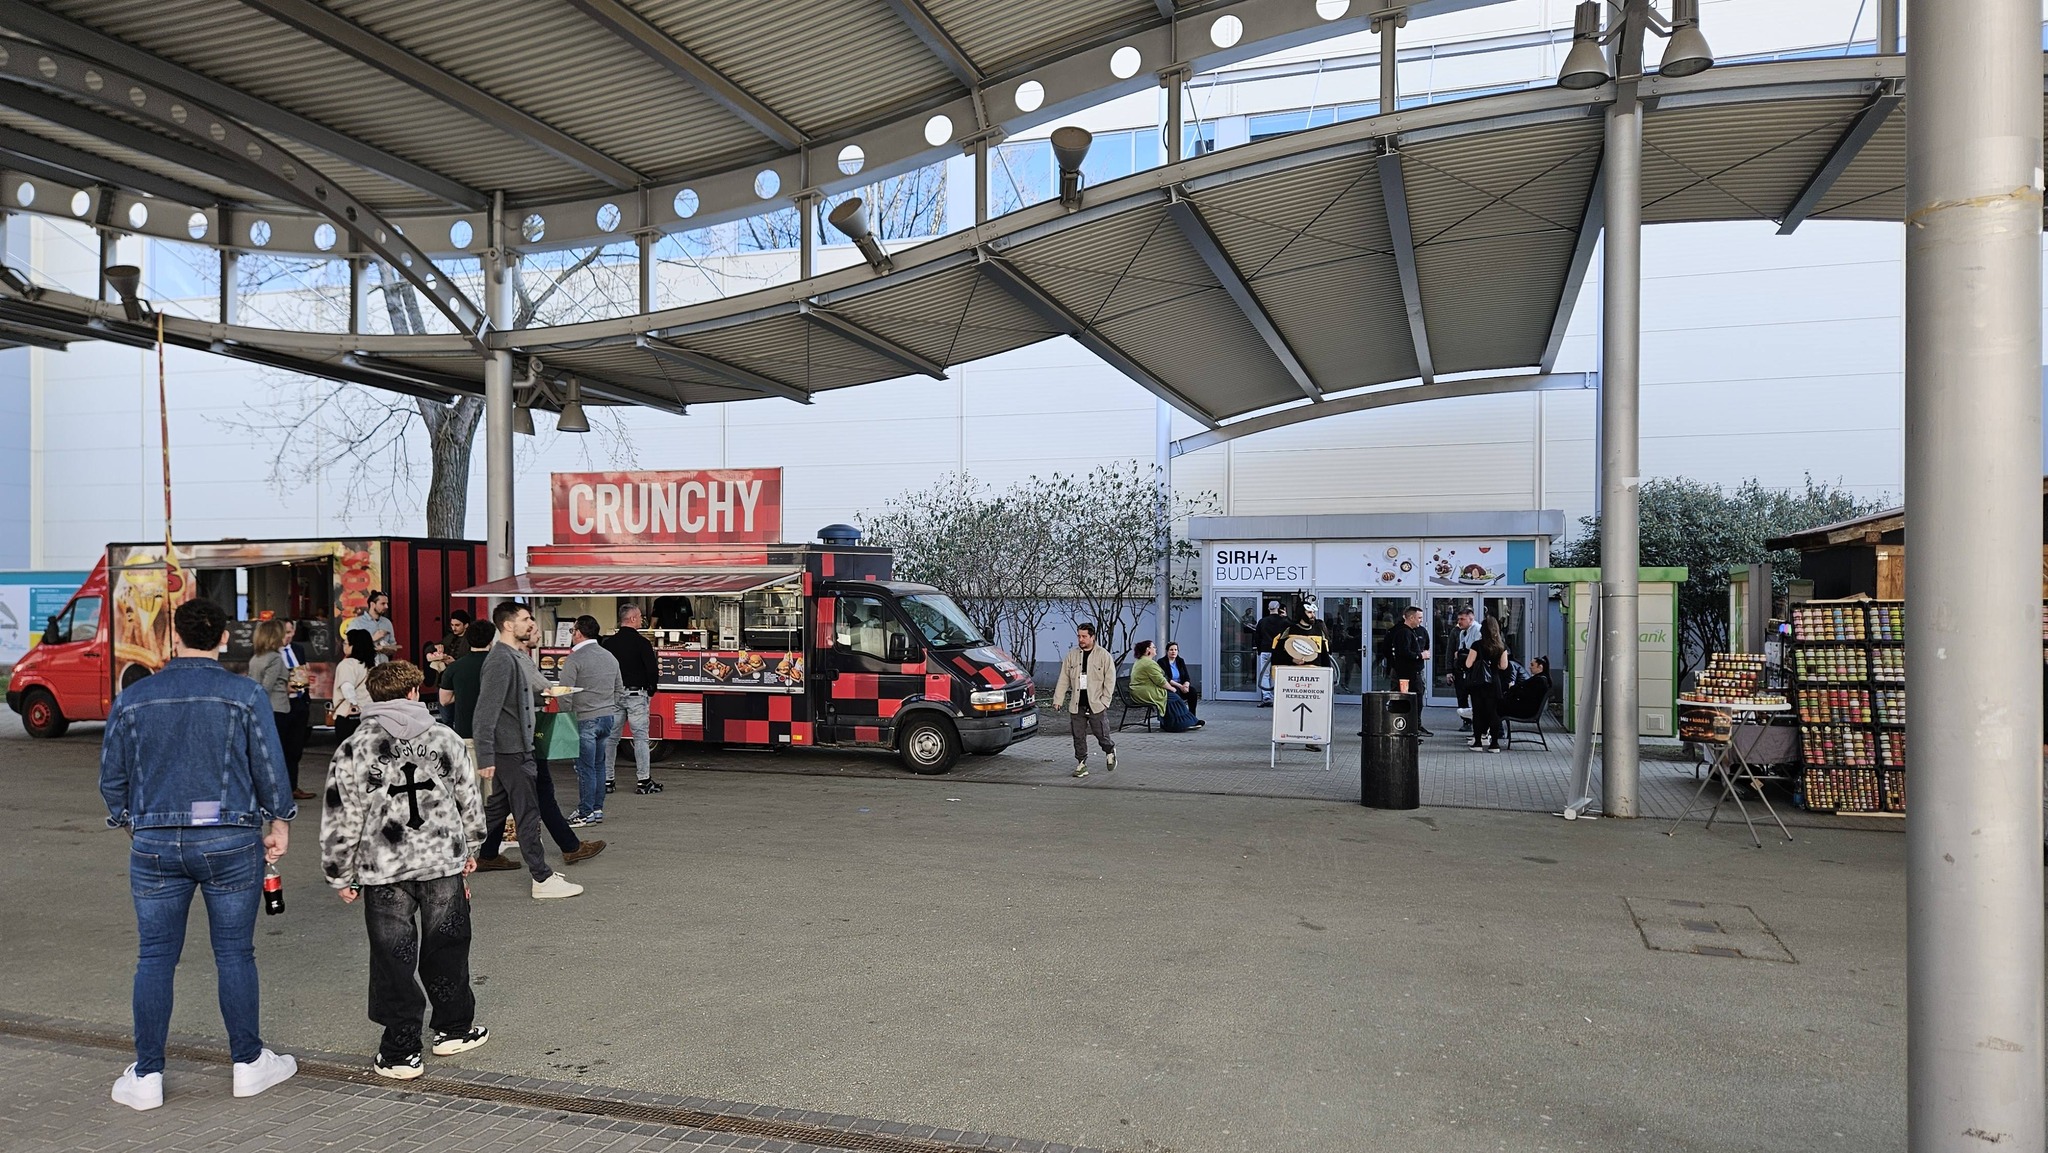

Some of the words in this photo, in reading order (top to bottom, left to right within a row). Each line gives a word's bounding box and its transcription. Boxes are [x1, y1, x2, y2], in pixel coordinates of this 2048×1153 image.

[568, 479, 763, 535] CRUNCHY
[1216, 566, 1308, 580] BUDAPEST
[535, 574, 757, 587] CRUNCHY
[1638, 630, 1666, 642] ank
